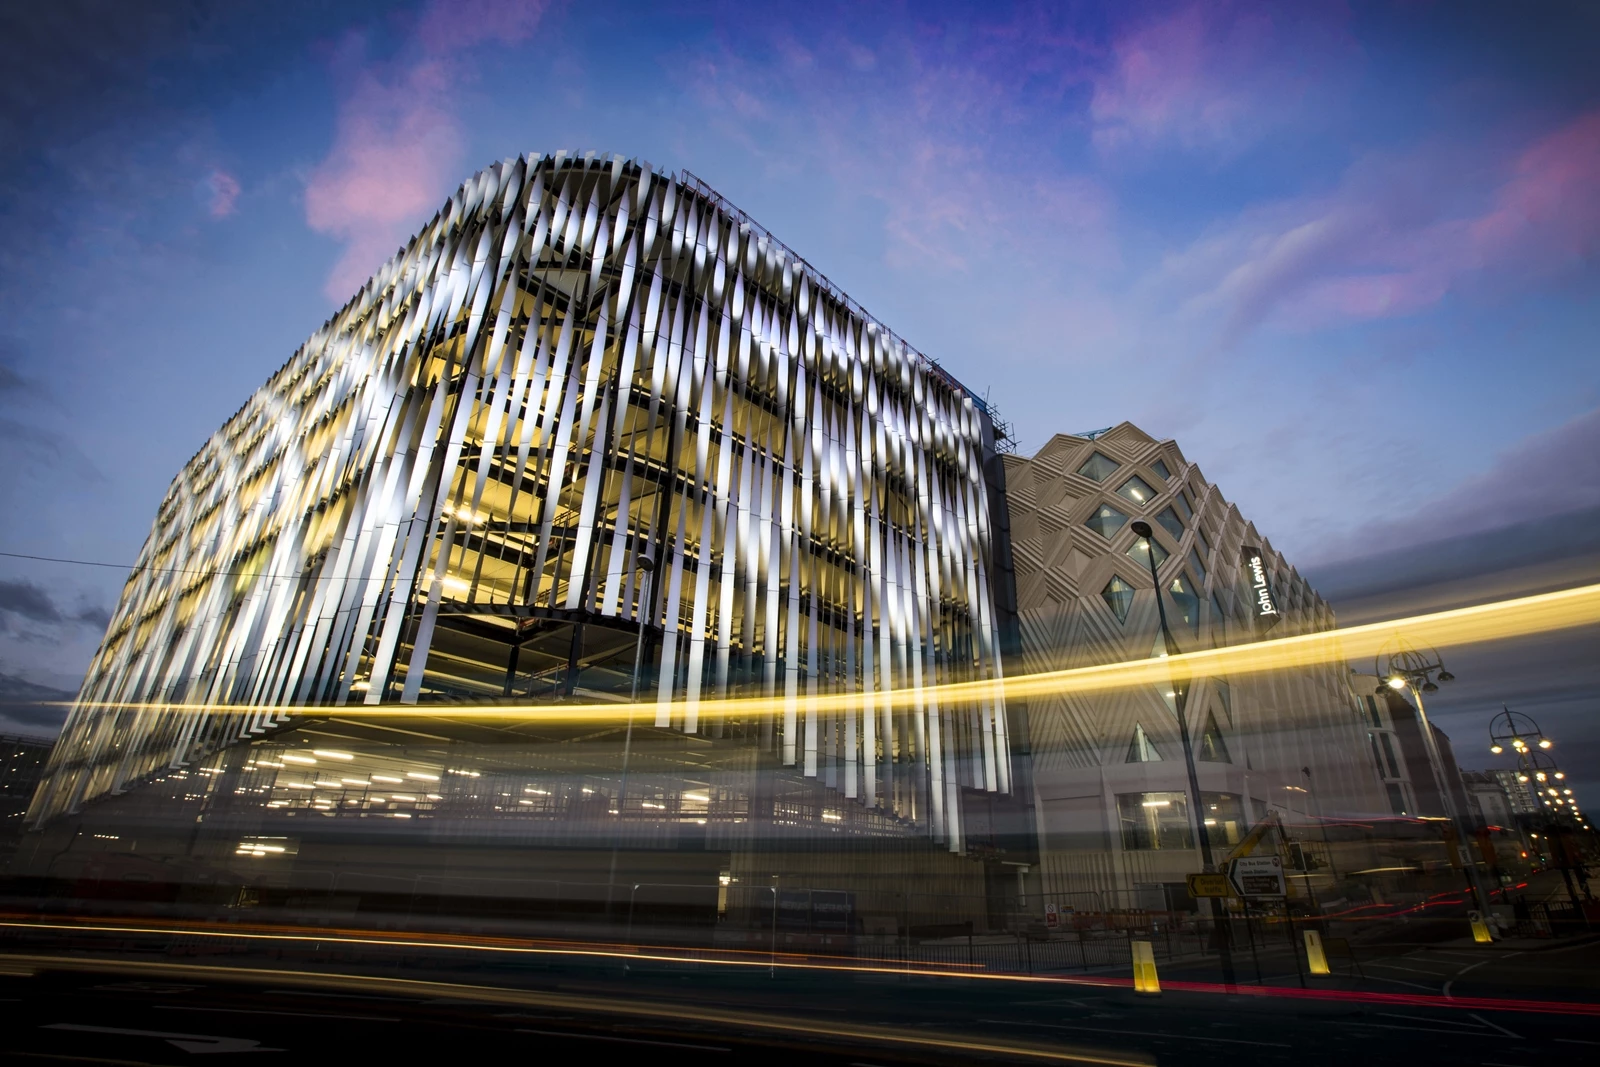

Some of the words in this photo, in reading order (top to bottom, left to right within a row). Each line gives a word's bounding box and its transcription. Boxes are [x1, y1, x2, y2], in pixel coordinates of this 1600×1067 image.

[1248, 556, 1266, 588] Lewis
[1258, 588, 1276, 616] John
[1200, 877, 1223, 885] Diverted
